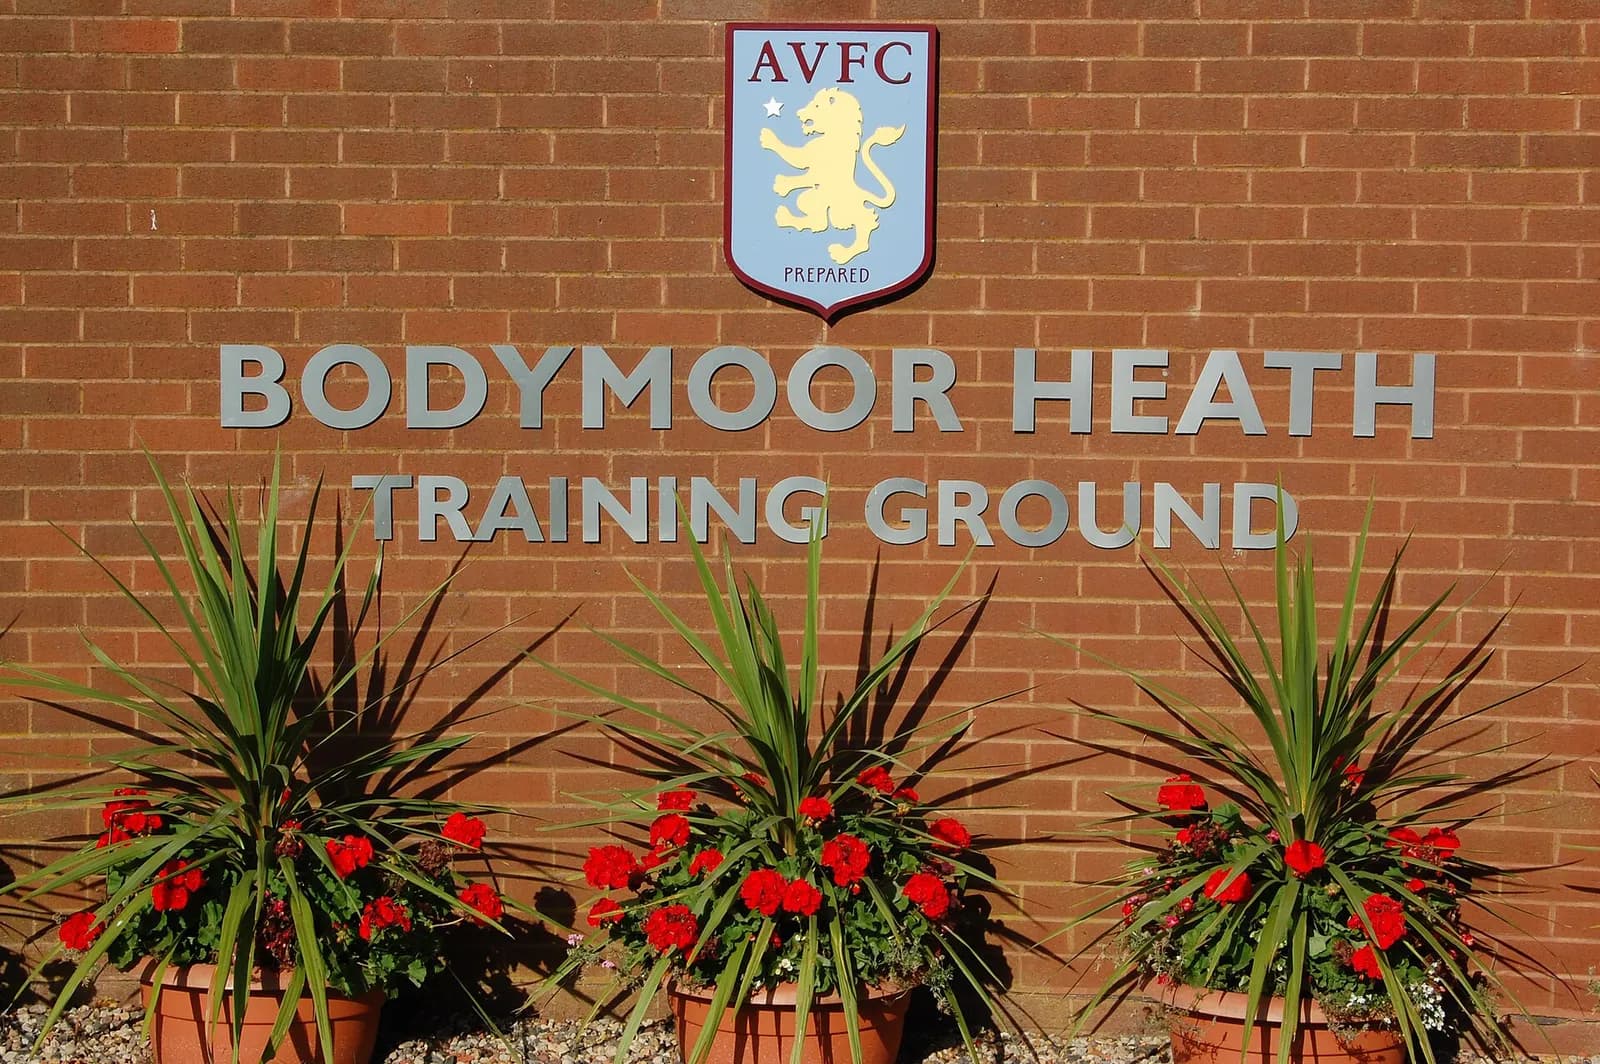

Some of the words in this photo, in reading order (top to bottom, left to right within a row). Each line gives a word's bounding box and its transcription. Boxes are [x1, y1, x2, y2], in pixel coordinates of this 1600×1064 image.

[748, 40, 912, 84] AVFC
[785, 267, 870, 283] PREPARED
[220, 344, 962, 433] BODYMOOR
[1012, 348, 1437, 438] HEATH
[352, 475, 830, 544] TRAINING
[864, 477, 1299, 550] GROUND
